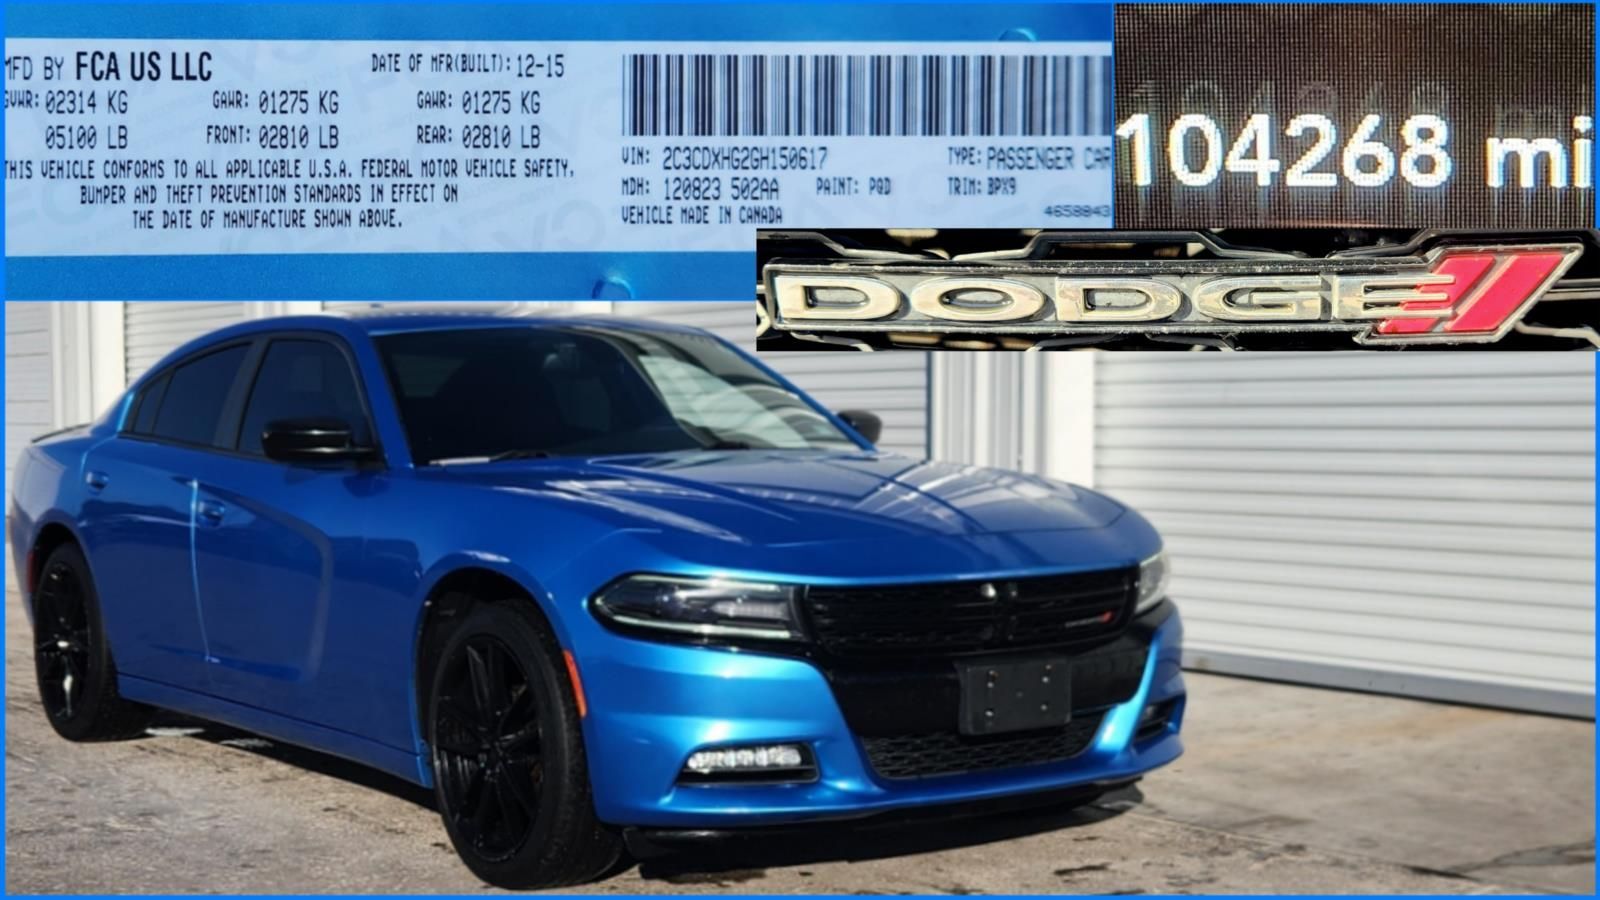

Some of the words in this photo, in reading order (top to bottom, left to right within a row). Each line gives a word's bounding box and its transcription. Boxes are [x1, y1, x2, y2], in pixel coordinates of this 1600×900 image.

[5, 56, 32, 80] MFD
[44, 56, 64, 80] BY
[76, 51, 120, 81] FCA
[130, 51, 161, 82] US
[171, 51, 212, 82] LLC
[372, 53, 400, 72] DATE
[409, 53, 423, 72] OF
[517, 54, 564, 78] 12-15
[45, 90, 96, 114] 02314
[108, 90, 127, 114] KG
[213, 90, 248, 109] GAWR:
[259, 90, 309, 114] 01275
[319, 90, 338, 114] KG
[417, 90, 452, 109] GAWR:
[462, 90, 511, 114] 01275
[521, 90, 540, 114] KG
[46, 125, 96, 149] 05100
[108, 125, 128, 149] LB
[207, 125, 250, 144] FRONT:
[259, 125, 308, 149] 02810
[319, 125, 338, 149] LB
[417, 125, 452, 144] REAR:
[462, 125, 511, 149] 02810
[521, 125, 540, 149] LB
[622, 146, 649, 165] VIN:
[663, 146, 827, 170] 2C3CDXHG2GH150617
[948, 147, 981, 165] TYPE:
[988, 146, 1074, 170] PASSENGER
[1085, 147, 1110, 170] CAR
[1115, 112, 1452, 188] 104268
[1485, 115, 1592, 188] mi
[41, 160, 94, 179] VEHICLE
[104, 160, 164, 179] CONFORMS
[174, 159, 187, 178] TO
[196, 160, 218, 179] ALL
[226, 159, 301, 178] APPLICABLE
[309, 159, 352, 178] U.S.A.
[362, 159, 413, 178] FEDERAL
[421, 159, 457, 178] MOTOR
[466, 158, 516, 178] VEHICLE
[80, 185, 126, 204] BUMPER
[134, 185, 157, 204] AND
[166, 184, 202, 204] THEFT
[211, 184, 286, 203] PREVENTION
[294, 184, 361, 203] STANDARDS
[371, 184, 383, 203] IN
[392, 184, 435, 203] EFFECT
[444, 184, 457, 202] ON
[622, 177, 649, 195] MDH:
[665, 177, 721, 200] 120823
[731, 177, 779, 200] 502AA
[817, 177, 858, 195] PAINT:
[870, 177, 891, 195] PQD
[948, 177, 981, 195] TRIM:
[988, 177, 1016, 195] BPX9
[133, 210, 154, 229] THE
[163, 210, 192, 229] DATE
[201, 210, 215, 228] OF
[224, 209, 306, 228] MANUFACTURE
[314, 209, 351, 228] SHOWN
[359, 209, 402, 228] ABOVE.
[622, 205, 672, 224] VEHICLE
[681, 205, 709, 224] MADE
[719, 206, 731, 224] IN
[739, 206, 782, 224] CANADA
[773, 273, 1456, 322] DODGE
